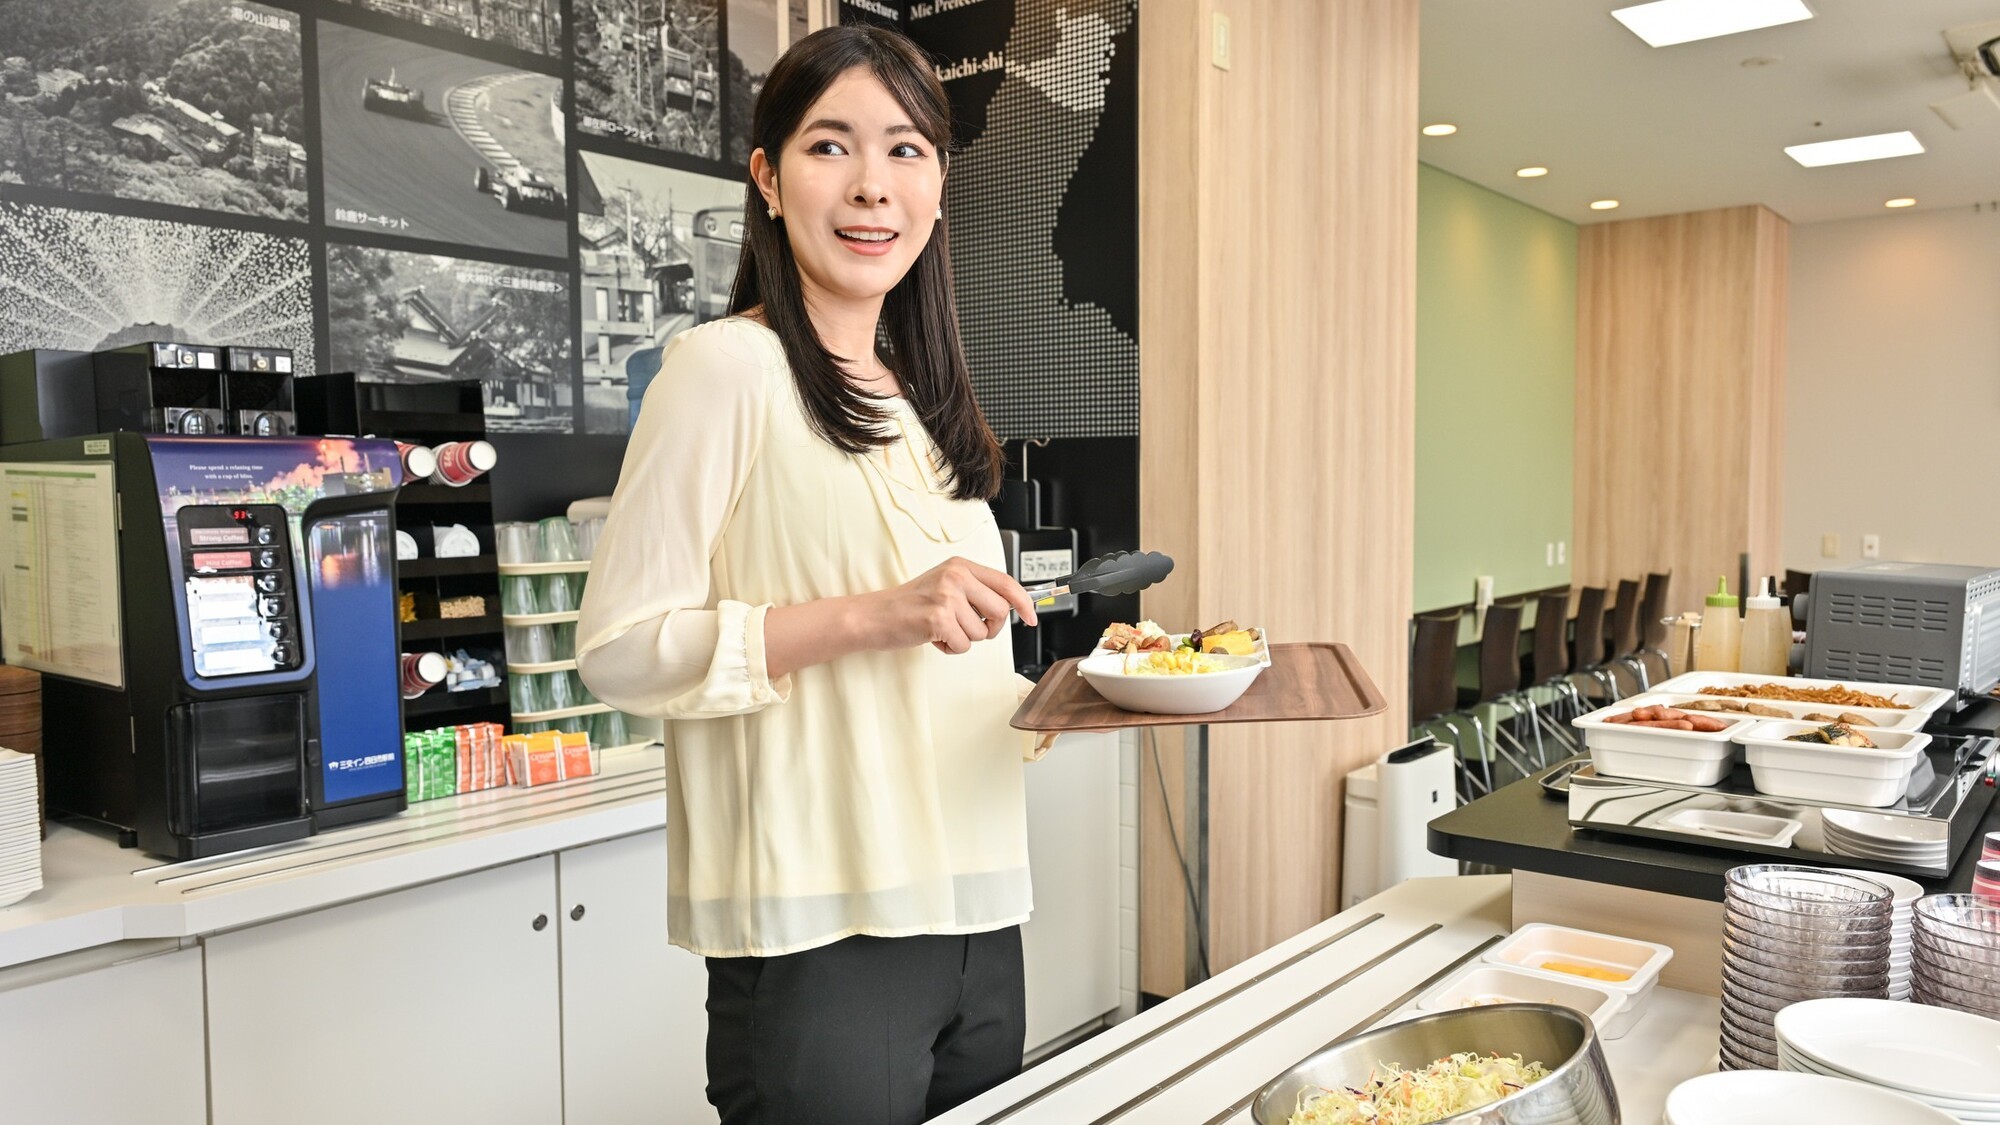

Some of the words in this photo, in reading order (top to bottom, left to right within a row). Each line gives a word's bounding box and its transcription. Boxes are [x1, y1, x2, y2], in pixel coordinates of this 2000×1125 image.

[231, 6, 290, 32] 湯の山温泉
[842, 0, 899, 21] refecture
[909, 3, 933, 21] Mie
[936, 50, 1004, 82] kaichi-shi
[335, 208, 410, 230] 鈴鹿サーキット
